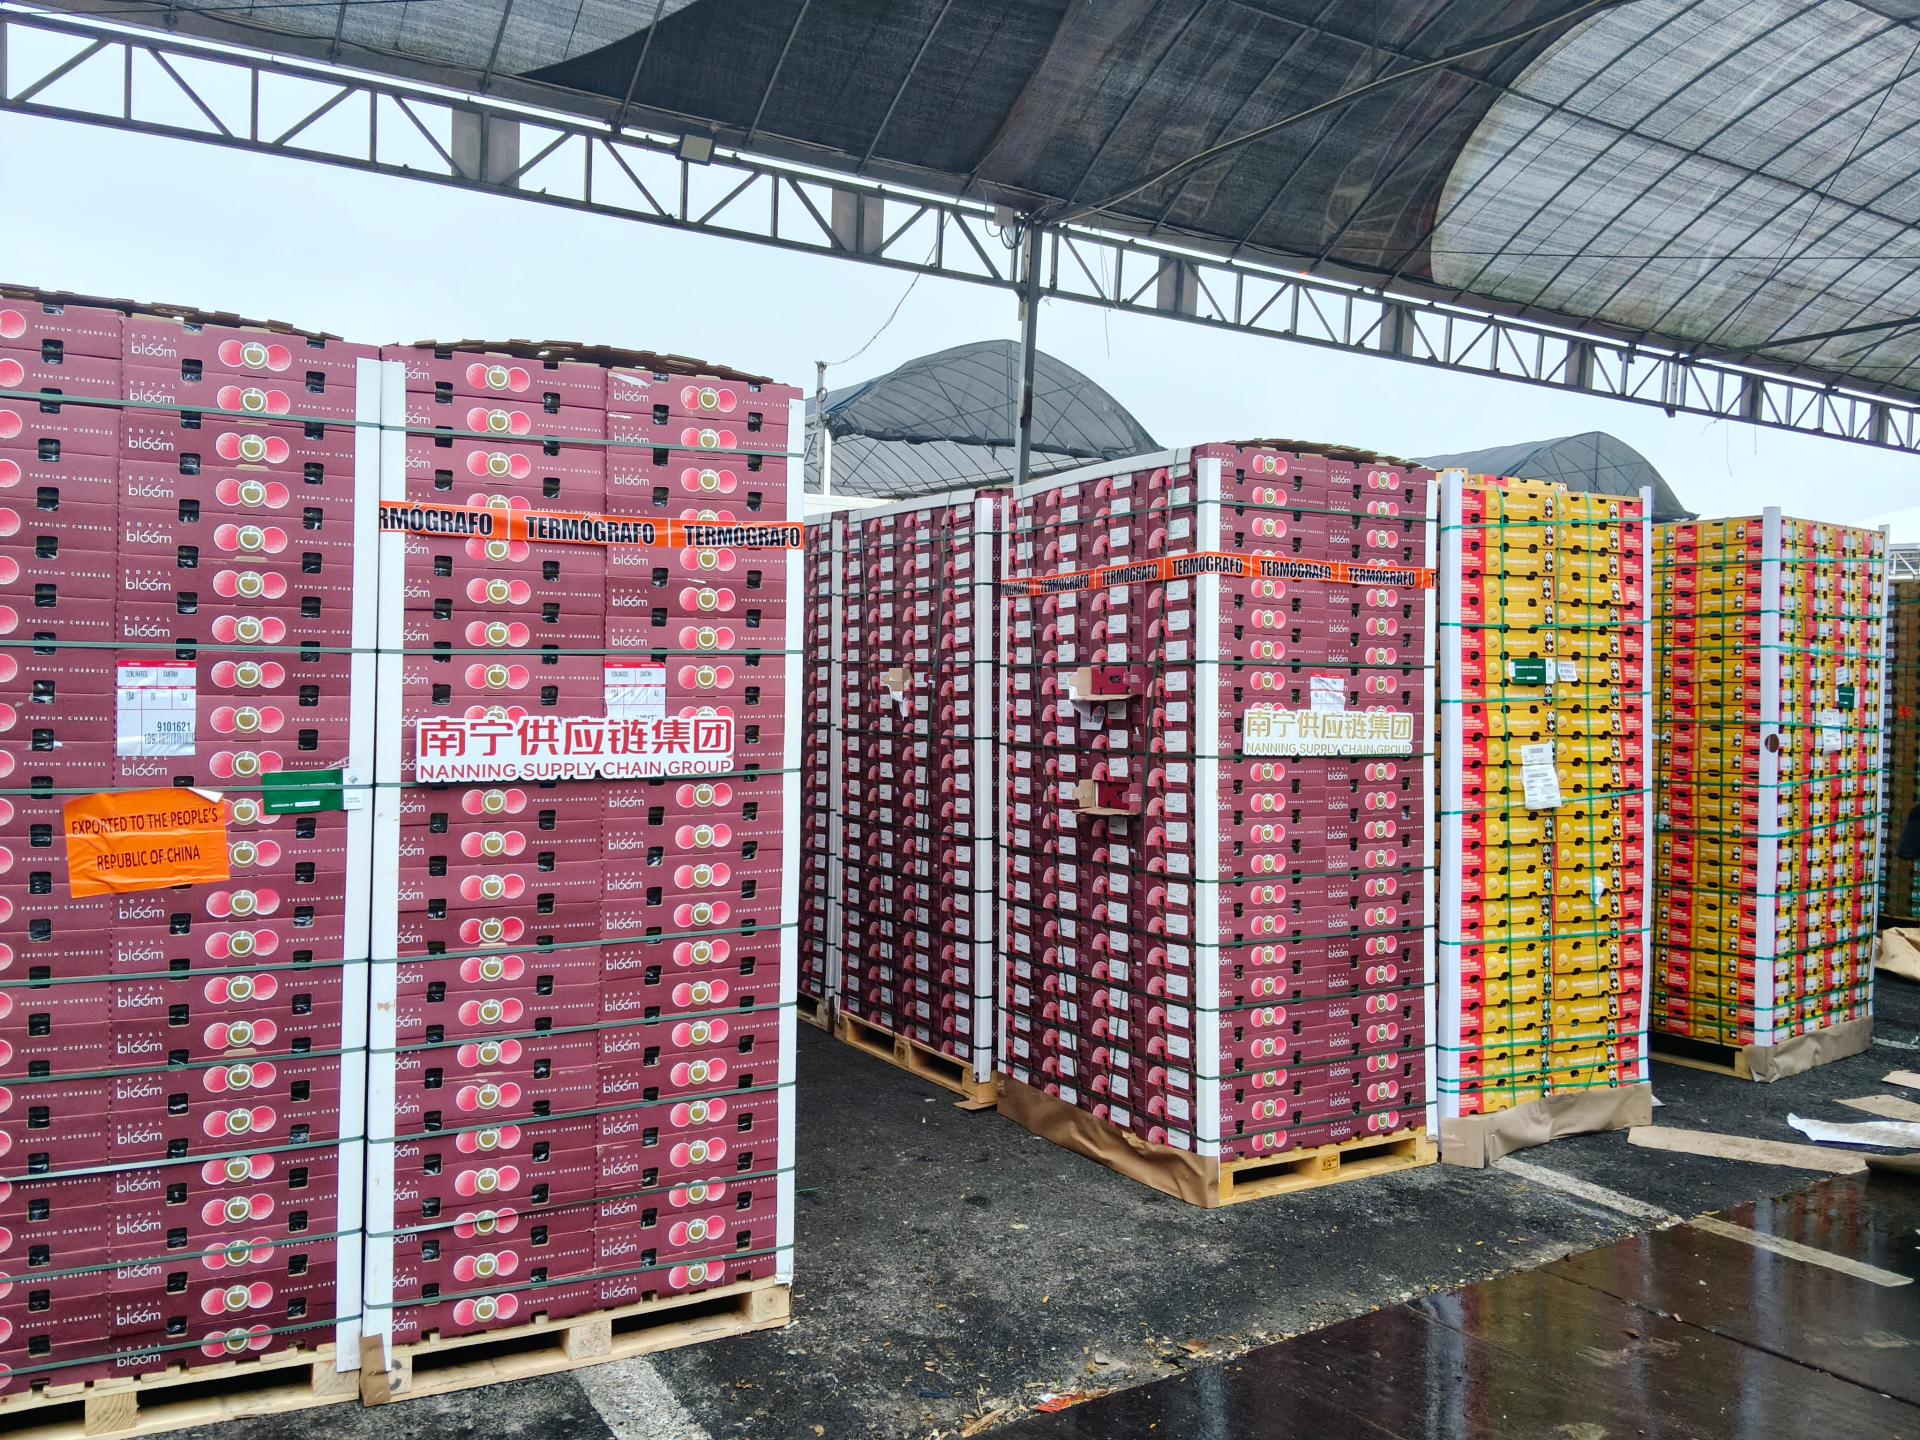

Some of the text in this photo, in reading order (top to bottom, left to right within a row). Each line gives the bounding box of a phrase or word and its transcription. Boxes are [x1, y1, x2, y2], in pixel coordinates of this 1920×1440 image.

[34, 324, 72, 333] PREMIUM
[299, 358, 333, 368] PREMIUM
[32, 373, 71, 382] PREMIUM
[30, 424, 68, 432] PREMIUM
[296, 449, 330, 457] PREMIUM
[525, 516, 655, 545] TERMÓGRAFO
[684, 522, 801, 547] TERMÓGRAFO
[157, 721, 191, 732] 9101621
[1247, 711, 1412, 740] 南宁供应链集团
[421, 720, 732, 757] 南宁供应链集团
[1246, 742, 1411, 754] NANNING SUPPLY CHAIN GROUP
[420, 760, 731, 779] NANNING SUPPLY CHAIN GROUP
[72, 807, 218, 834] EXPORTED TO THE PEOPLE'S
[97, 845, 200, 870] REPUBLIC OF CHINA
[284, 1024, 318, 1032] PREMIUM
[20, 1046, 58, 1054] PREMIUM
[20, 1136, 57, 1144] PREMIUM
[20, 1231, 58, 1239] PREMIUM
